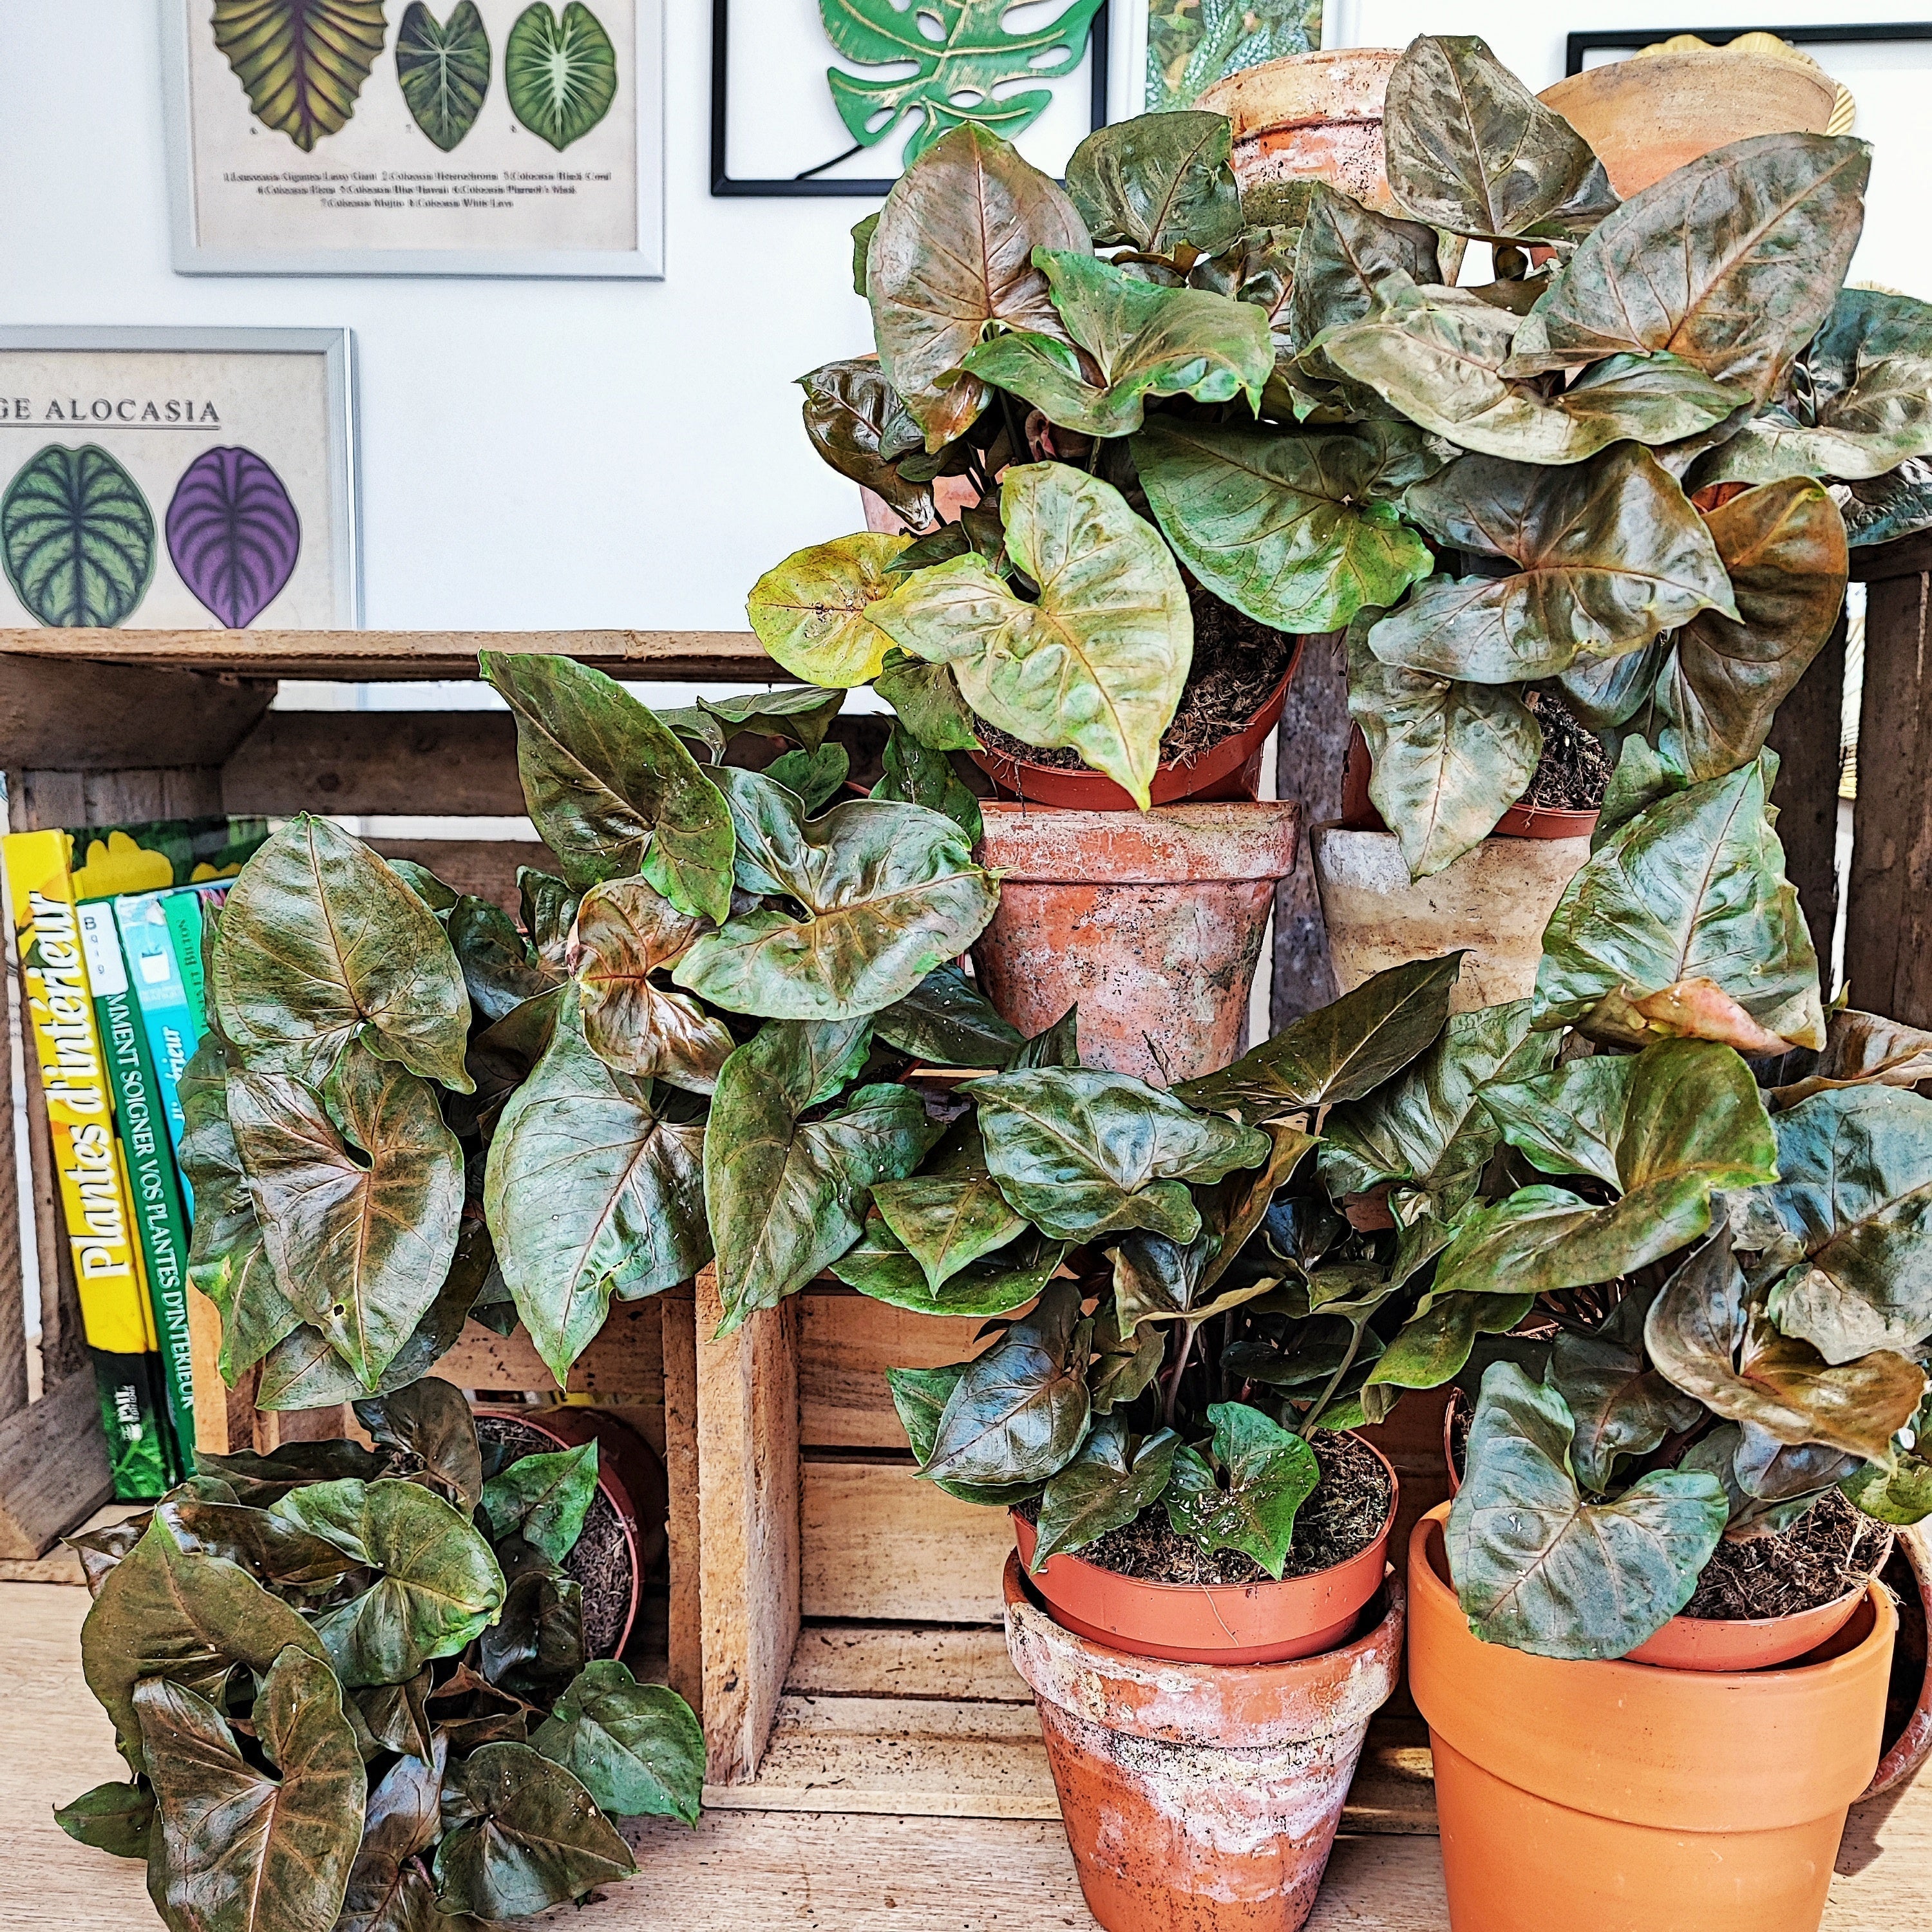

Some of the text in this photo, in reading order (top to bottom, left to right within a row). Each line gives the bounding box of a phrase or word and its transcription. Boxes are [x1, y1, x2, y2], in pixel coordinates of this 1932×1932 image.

[45, 398, 220, 422] ALOCASIA
[26, 891, 130, 1279] Plantes d'intérieur
[120, 1070, 156, 1159] SOIGNER
[137, 1159, 166, 1202] VOS
[145, 1202, 179, 1288] PLANTES
